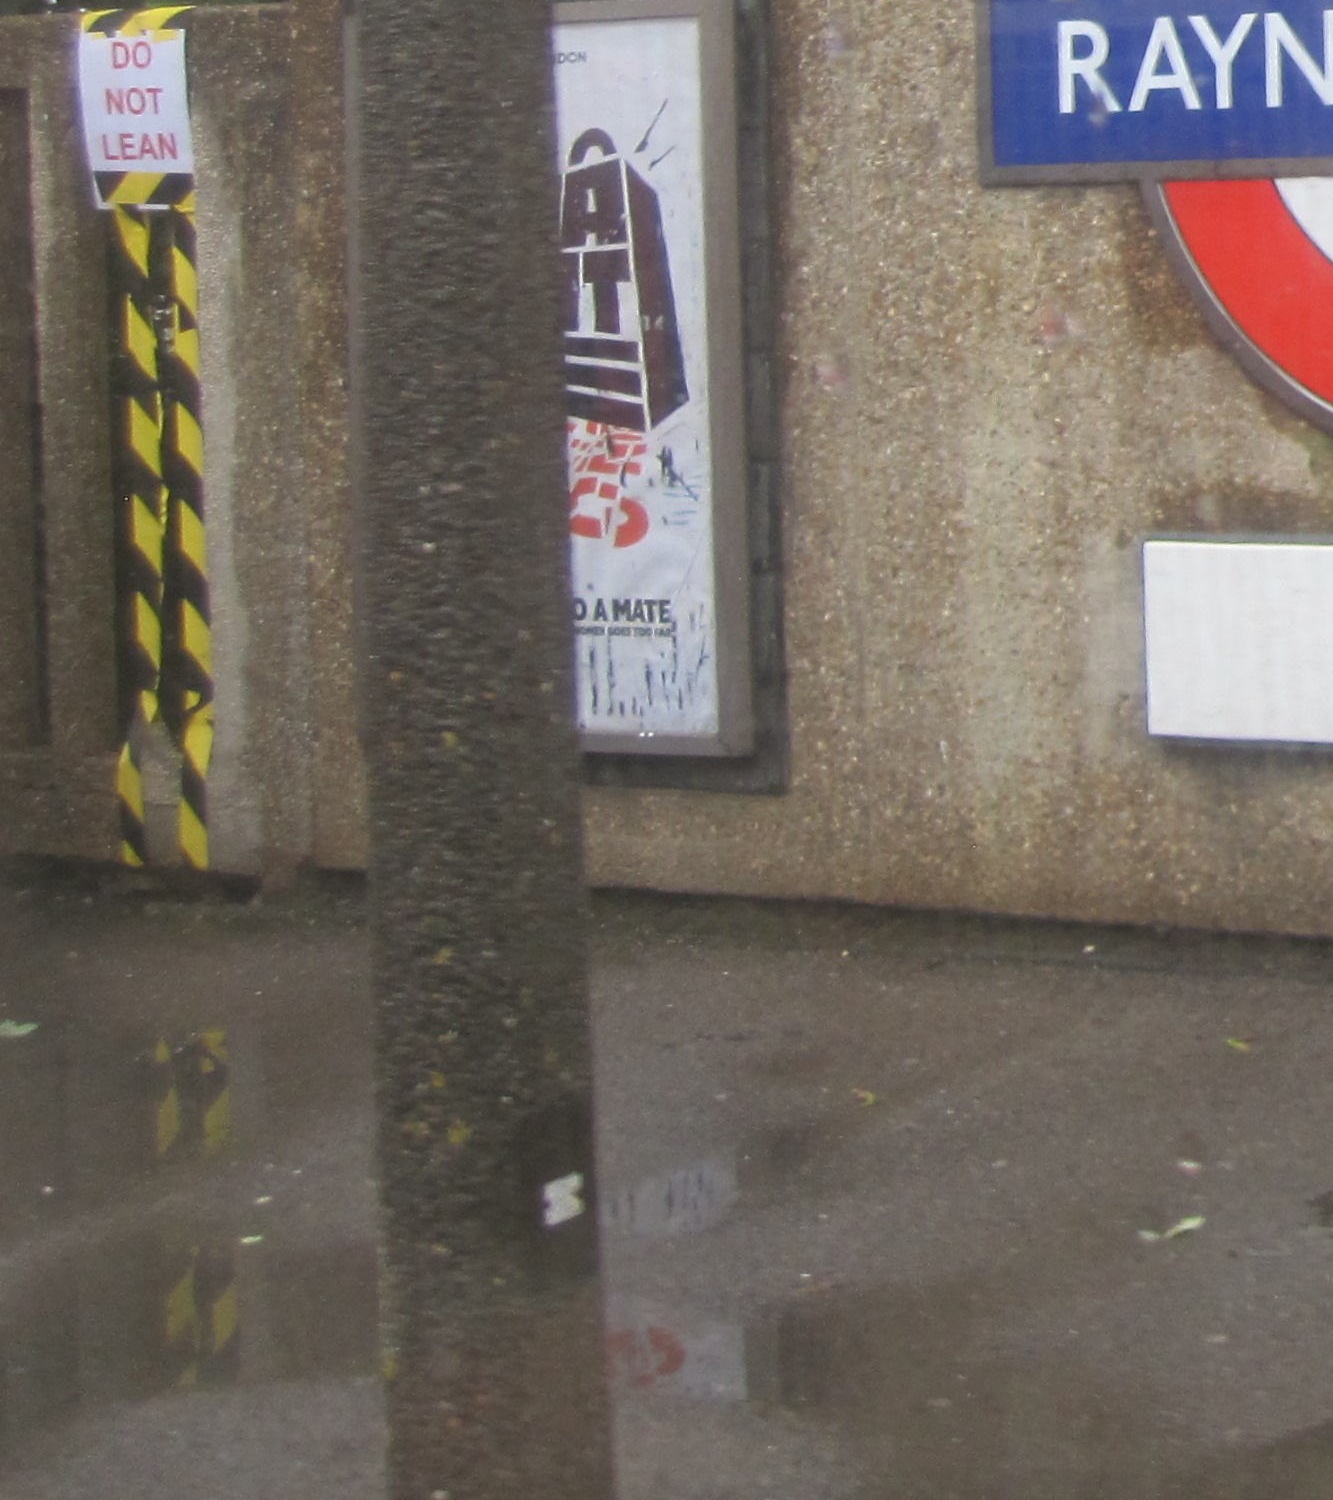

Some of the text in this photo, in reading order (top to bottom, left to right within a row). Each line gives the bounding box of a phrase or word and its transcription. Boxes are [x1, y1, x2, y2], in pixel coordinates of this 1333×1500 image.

[111, 40, 153, 70] DO
[104, 86, 164, 116] NOT
[102, 132, 179, 161] LEAN
[593, 598, 608, 621] A
[611, 598, 671, 623] MATE
